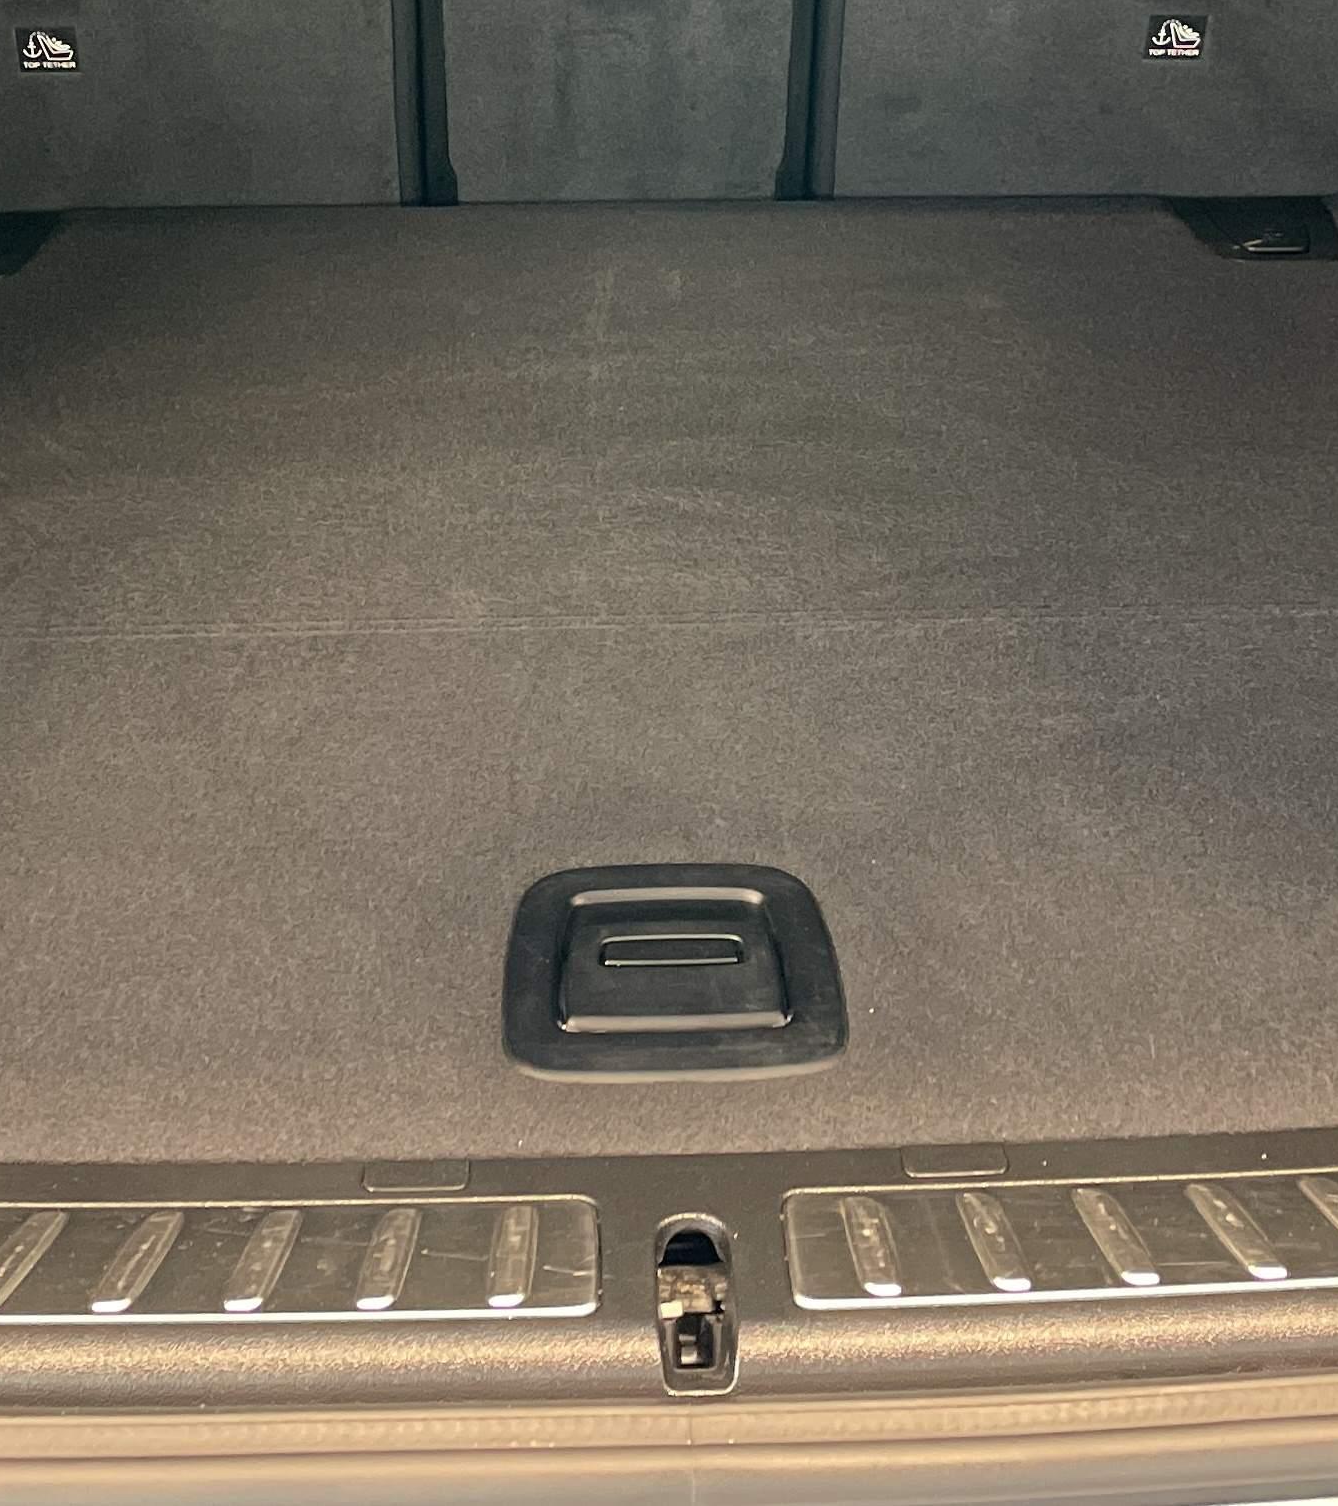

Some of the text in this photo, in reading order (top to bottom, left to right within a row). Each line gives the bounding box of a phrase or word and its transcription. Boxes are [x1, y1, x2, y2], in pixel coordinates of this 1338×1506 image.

[1148, 48, 1200, 57] TOP TETHER
[23, 61, 76, 69] TOP TETHER
